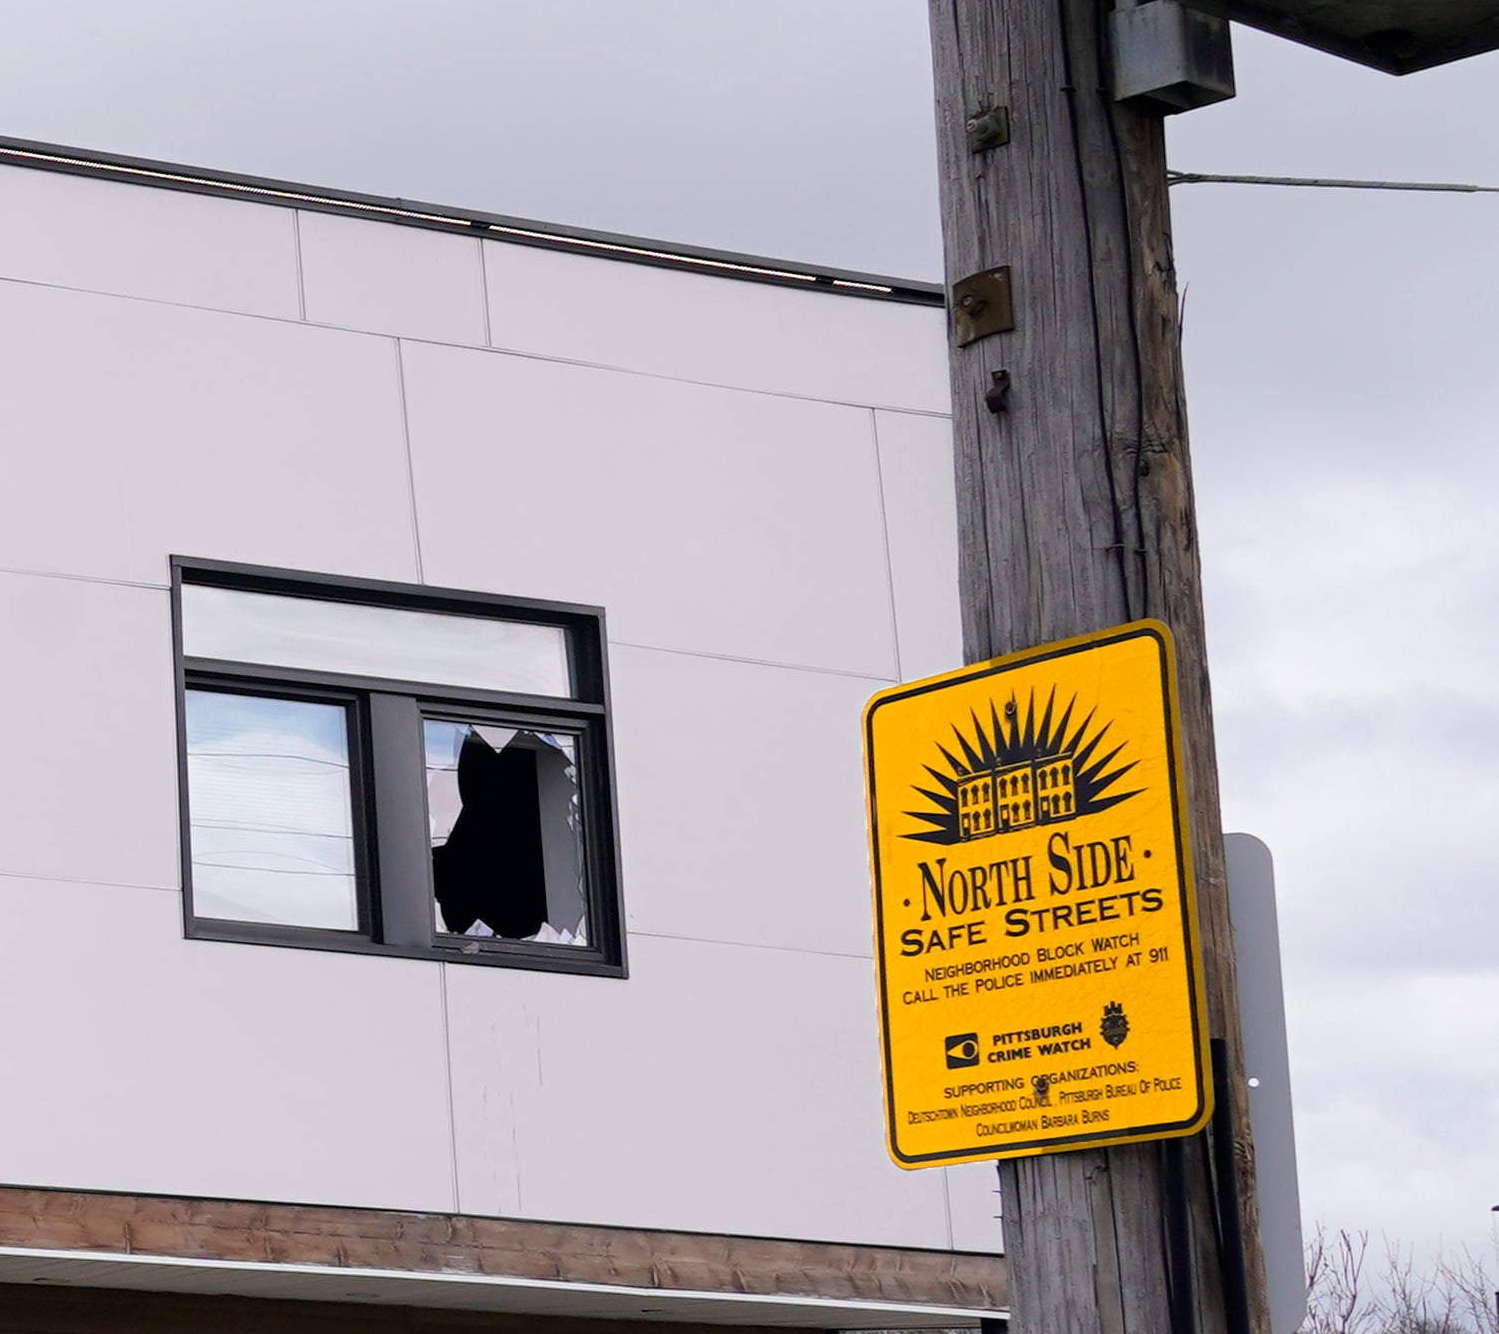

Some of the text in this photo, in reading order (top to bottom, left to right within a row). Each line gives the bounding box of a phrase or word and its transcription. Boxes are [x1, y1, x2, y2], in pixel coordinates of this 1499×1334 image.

[917, 831, 1135, 922] NORTH SIDE
[900, 888, 1164, 957] SAFE STREETS
[902, 946, 1169, 1006] CALL THE POLICE IMMEDIATELY AT 911
[924, 932, 1140, 983] NEIGHBORHOOD BLOCK WATCH
[987, 1037, 1092, 1064] CRIME WATCH
[992, 1021, 1083, 1047] PITTSBURGH
[943, 1077, 1025, 1099] SUPPORTING
[960, 1100, 1017, 1118] NEIGHBORHOOD
[1059, 1087, 1104, 1106] PITTSBURGH
[1105, 1083, 1137, 1099] BUREAU
[1139, 1079, 1151, 1094] OF
[1153, 1077, 1182, 1093] POLICE
[975, 1109, 1110, 1137] COUNCILWOMAN BARBARA BURNS
